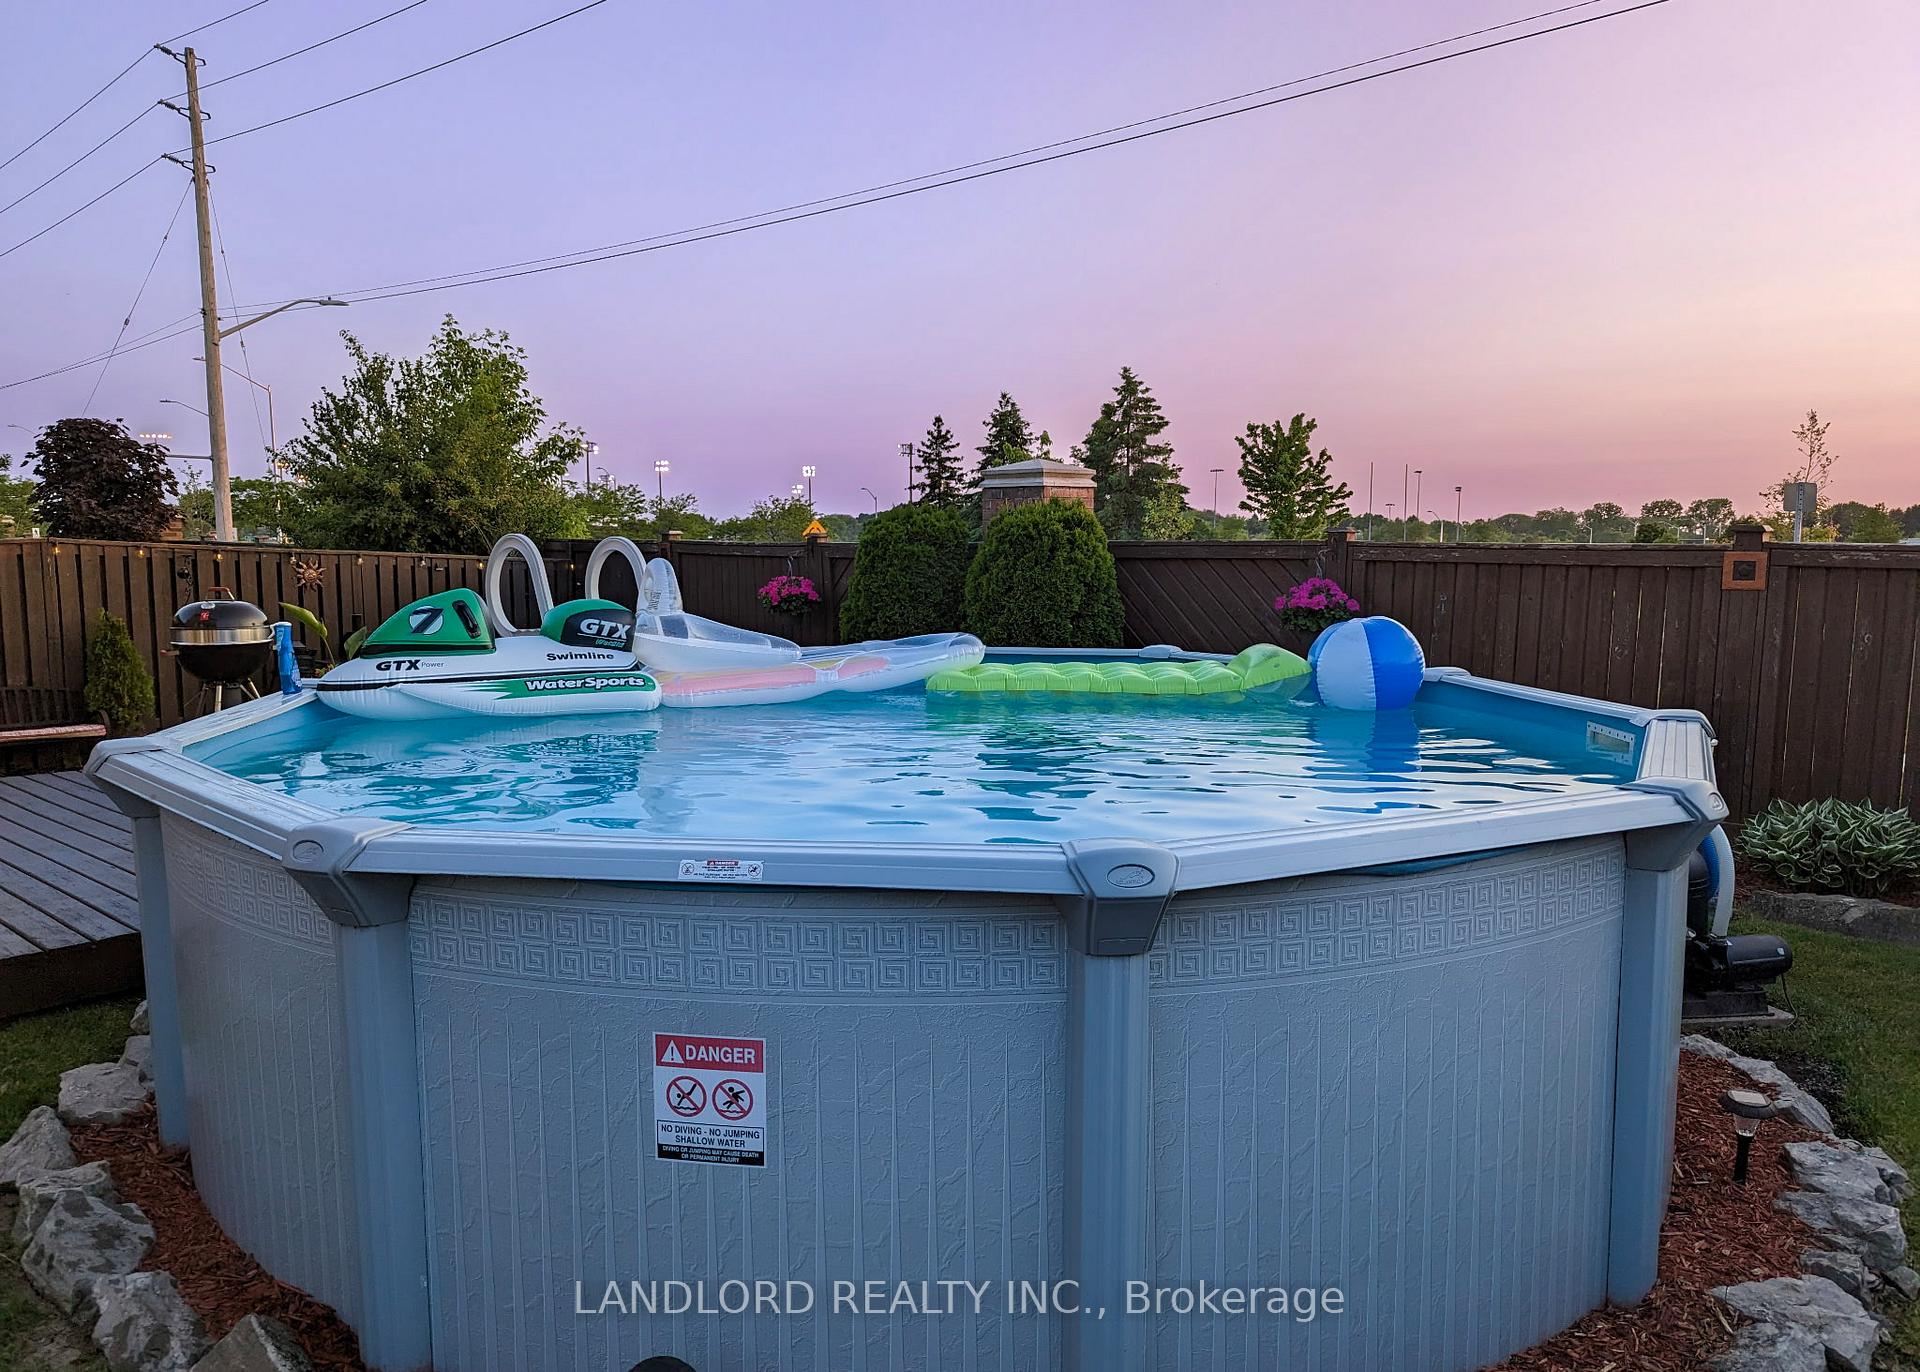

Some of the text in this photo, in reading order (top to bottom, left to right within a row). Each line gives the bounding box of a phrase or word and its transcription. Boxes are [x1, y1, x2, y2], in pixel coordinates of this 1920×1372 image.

[580, 618, 631, 640] GTX
[546, 652, 615, 661] Swimline
[376, 660, 421, 671] GTX
[526, 677, 646, 690] WaterSports
[685, 1044, 756, 1064] DANGER
[661, 1124, 673, 1133] NO
[675, 1125, 702, 1136] DIVING
[709, 1128, 722, 1137] NO
[723, 1129, 760, 1139] JUMPING
[675, 1135, 746, 1148] SHALLOW WATER
